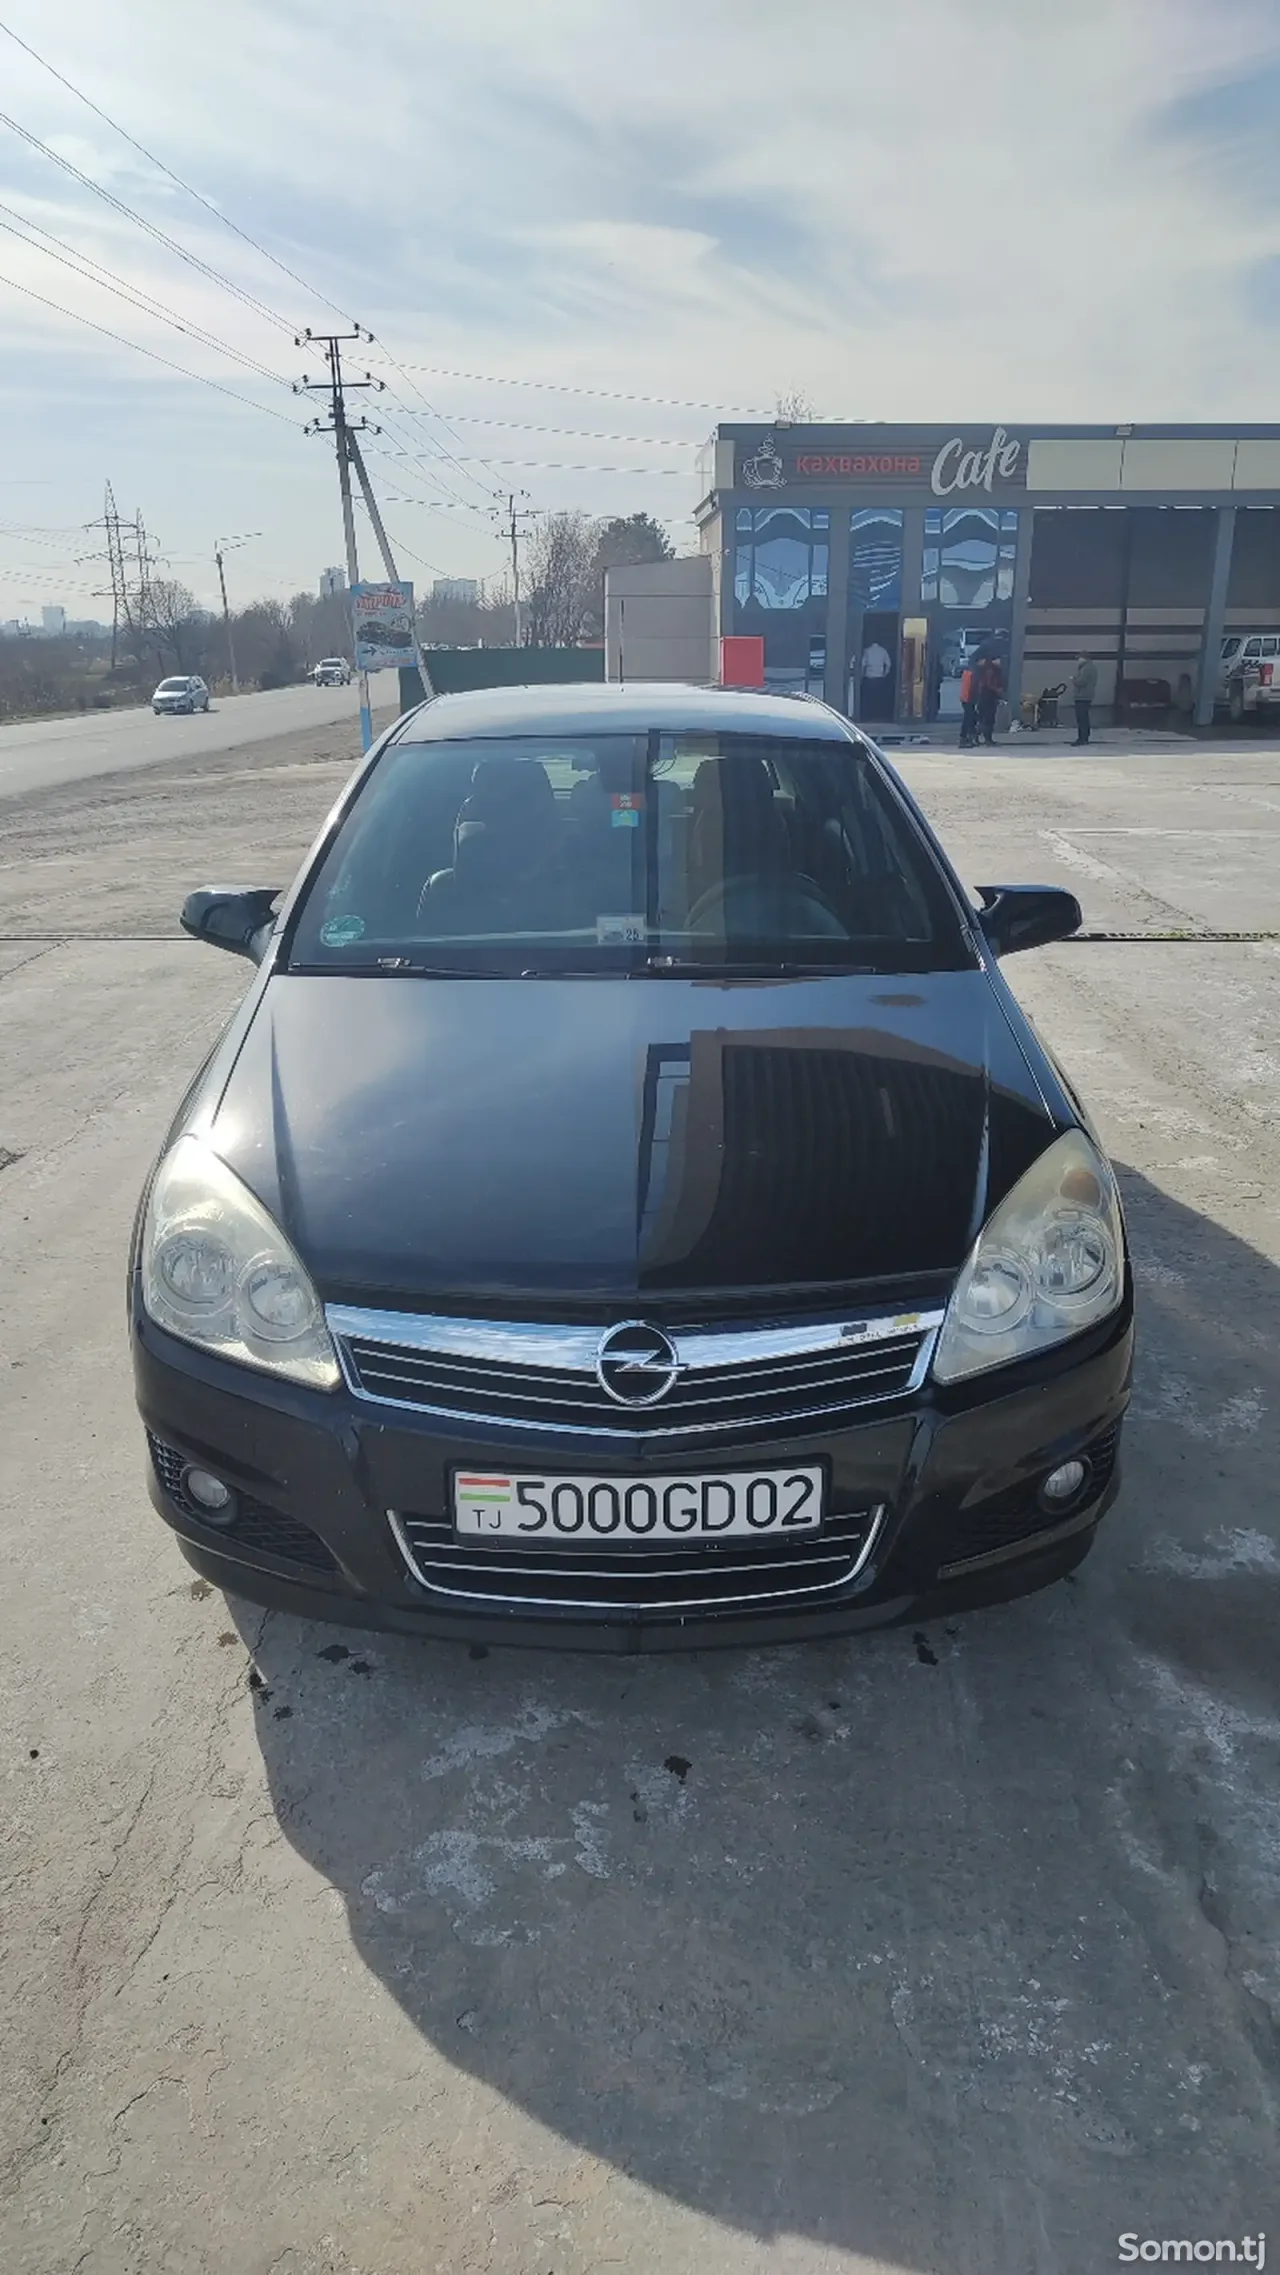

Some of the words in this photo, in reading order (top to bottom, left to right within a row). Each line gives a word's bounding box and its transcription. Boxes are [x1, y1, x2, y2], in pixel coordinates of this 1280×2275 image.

[931, 425, 1021, 496] Cafe
[472, 1508, 502, 1530] TJ
[516, 1474, 815, 1534] 5000GD02
